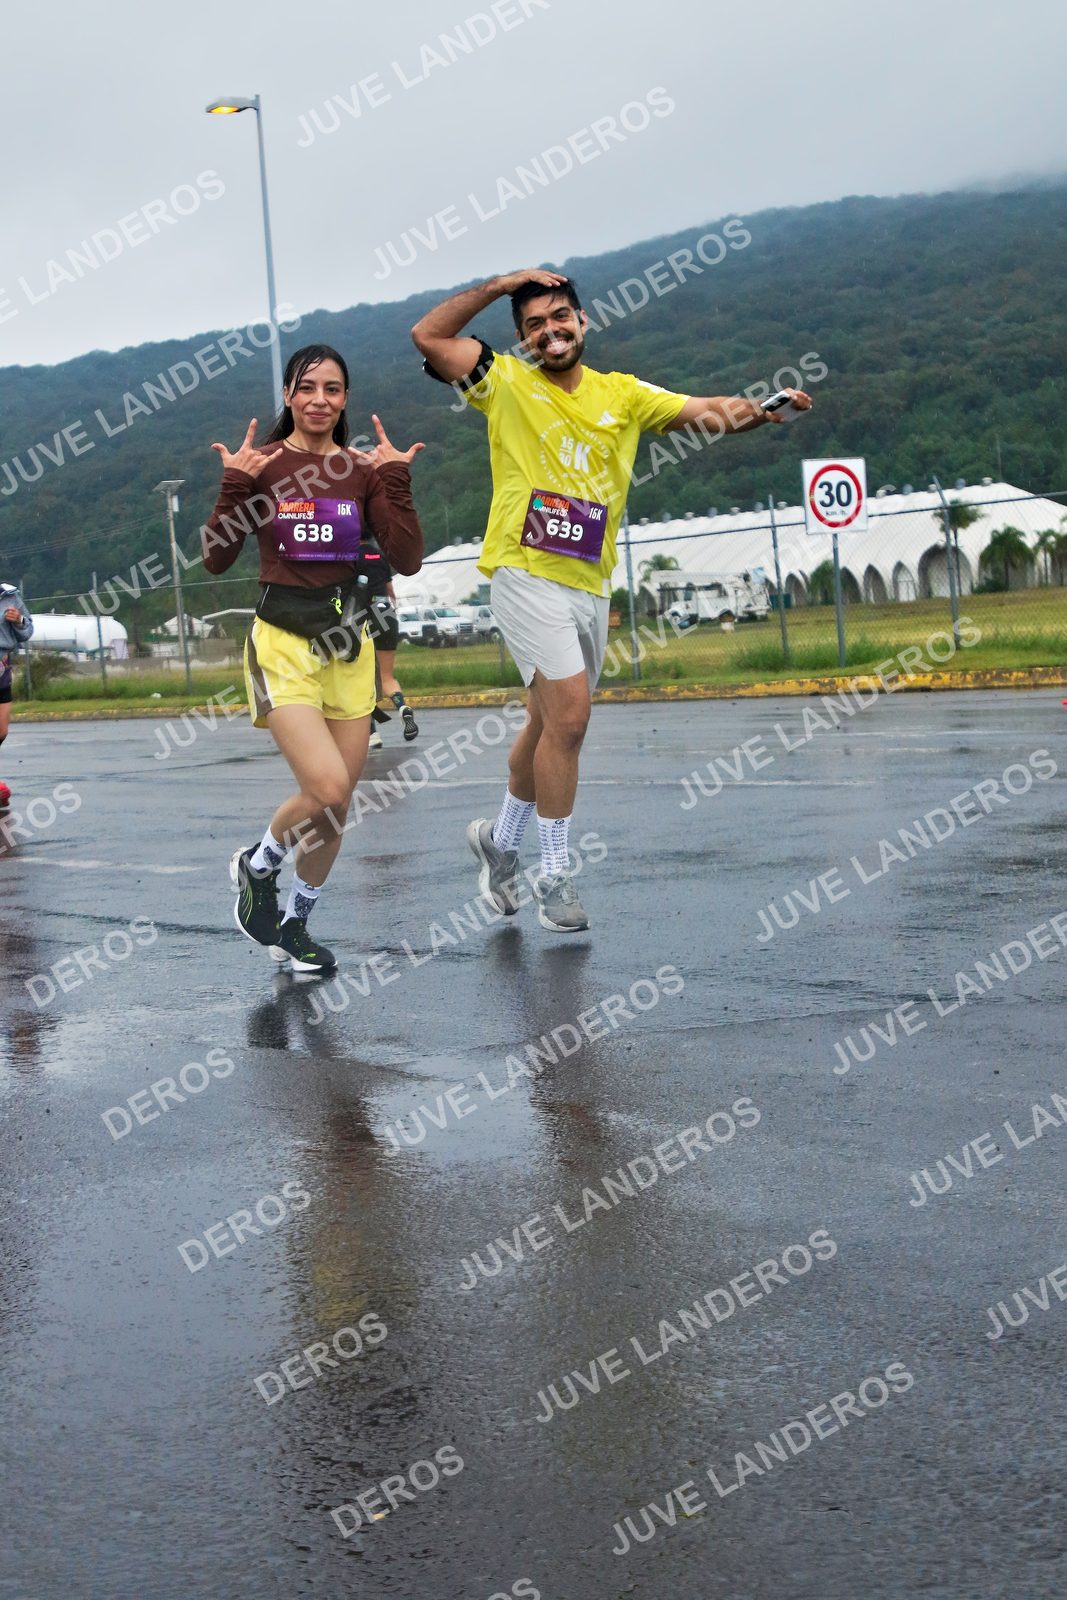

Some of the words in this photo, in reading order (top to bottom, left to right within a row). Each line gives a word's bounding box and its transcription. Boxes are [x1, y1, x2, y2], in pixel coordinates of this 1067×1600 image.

[818, 480, 852, 507] 30
[278, 502, 315, 512] CARRERA
[293, 523, 334, 542] 638
[546, 518, 584, 541] 639
